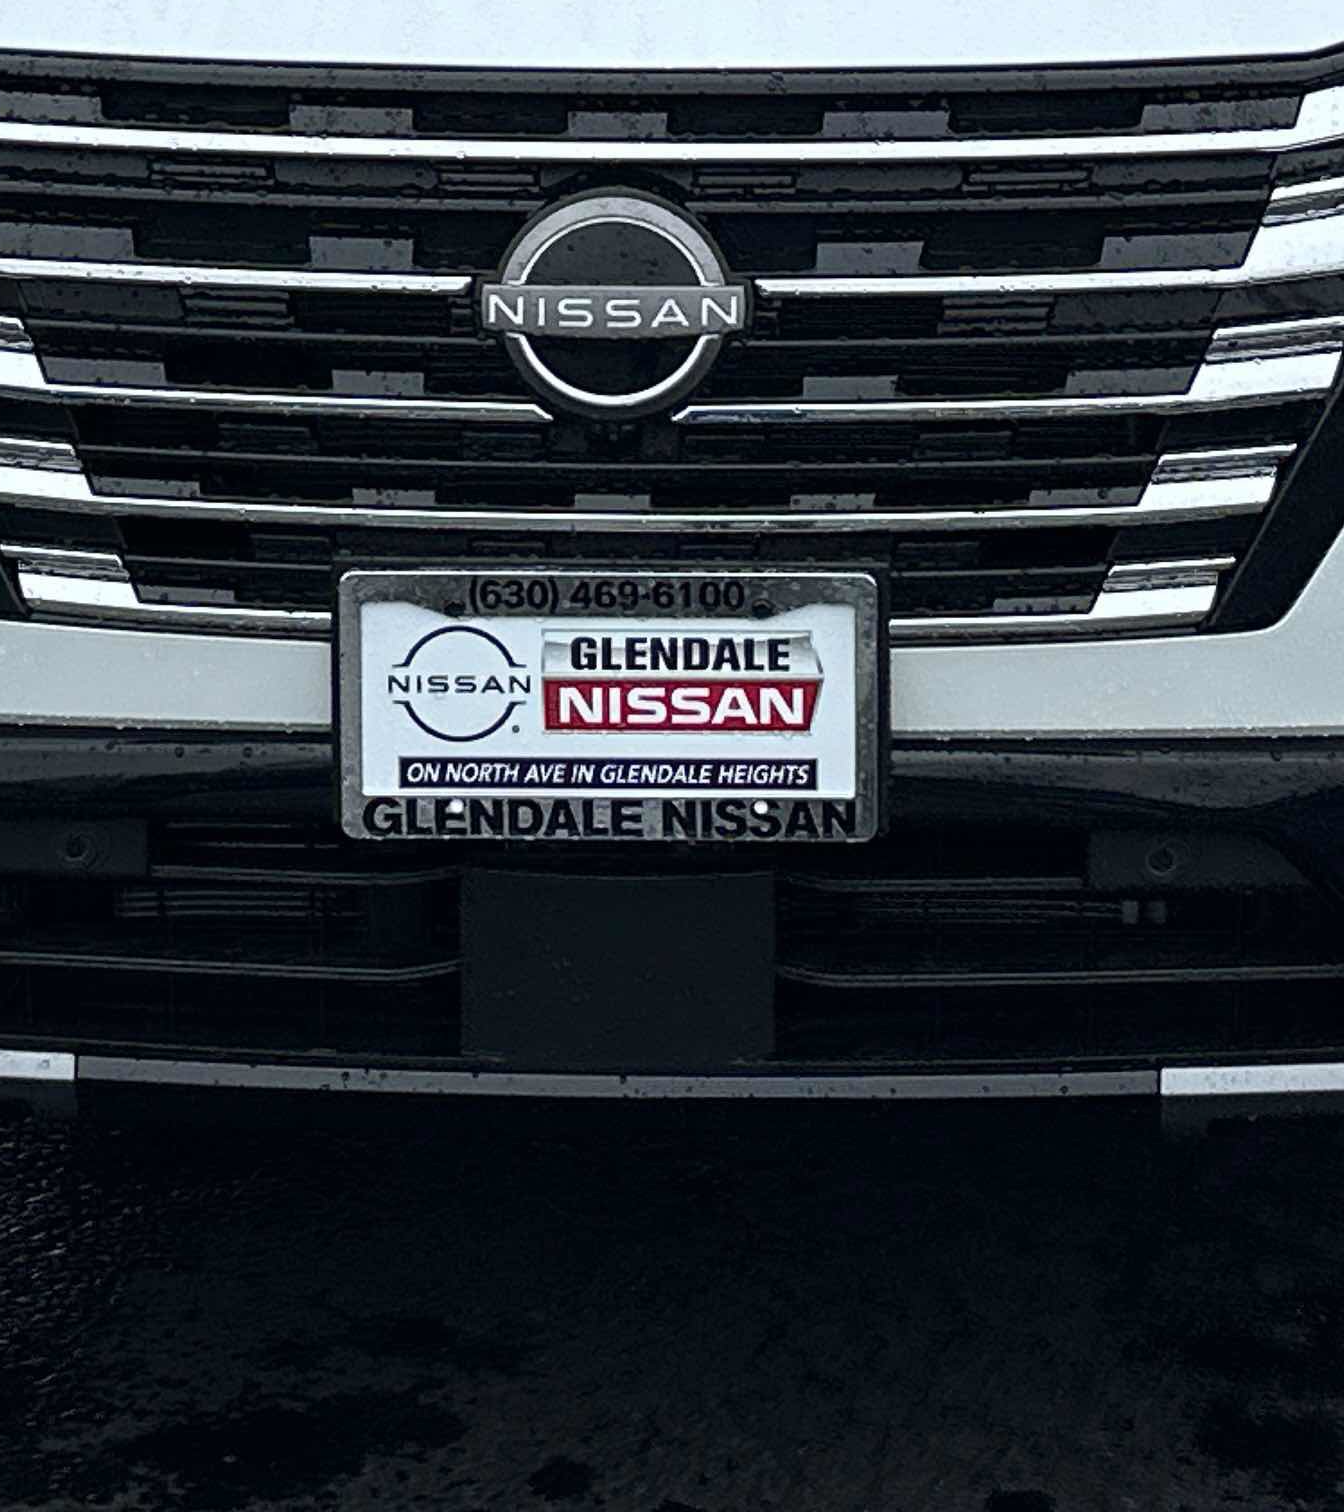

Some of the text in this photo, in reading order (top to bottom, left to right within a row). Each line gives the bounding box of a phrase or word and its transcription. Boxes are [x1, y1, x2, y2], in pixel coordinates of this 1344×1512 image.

[488, 294, 738, 328] NISSAN
[470, 575, 746, 614] (630) 469-6100
[570, 637, 791, 672] GLENDALE
[388, 674, 531, 694] NISSAN
[559, 687, 805, 725] NISSAN
[407, 762, 811, 785] ON NORTH AVE IN GLENDALE HEIGHTS
[362, 797, 856, 838] GLENDALE NISSAN
